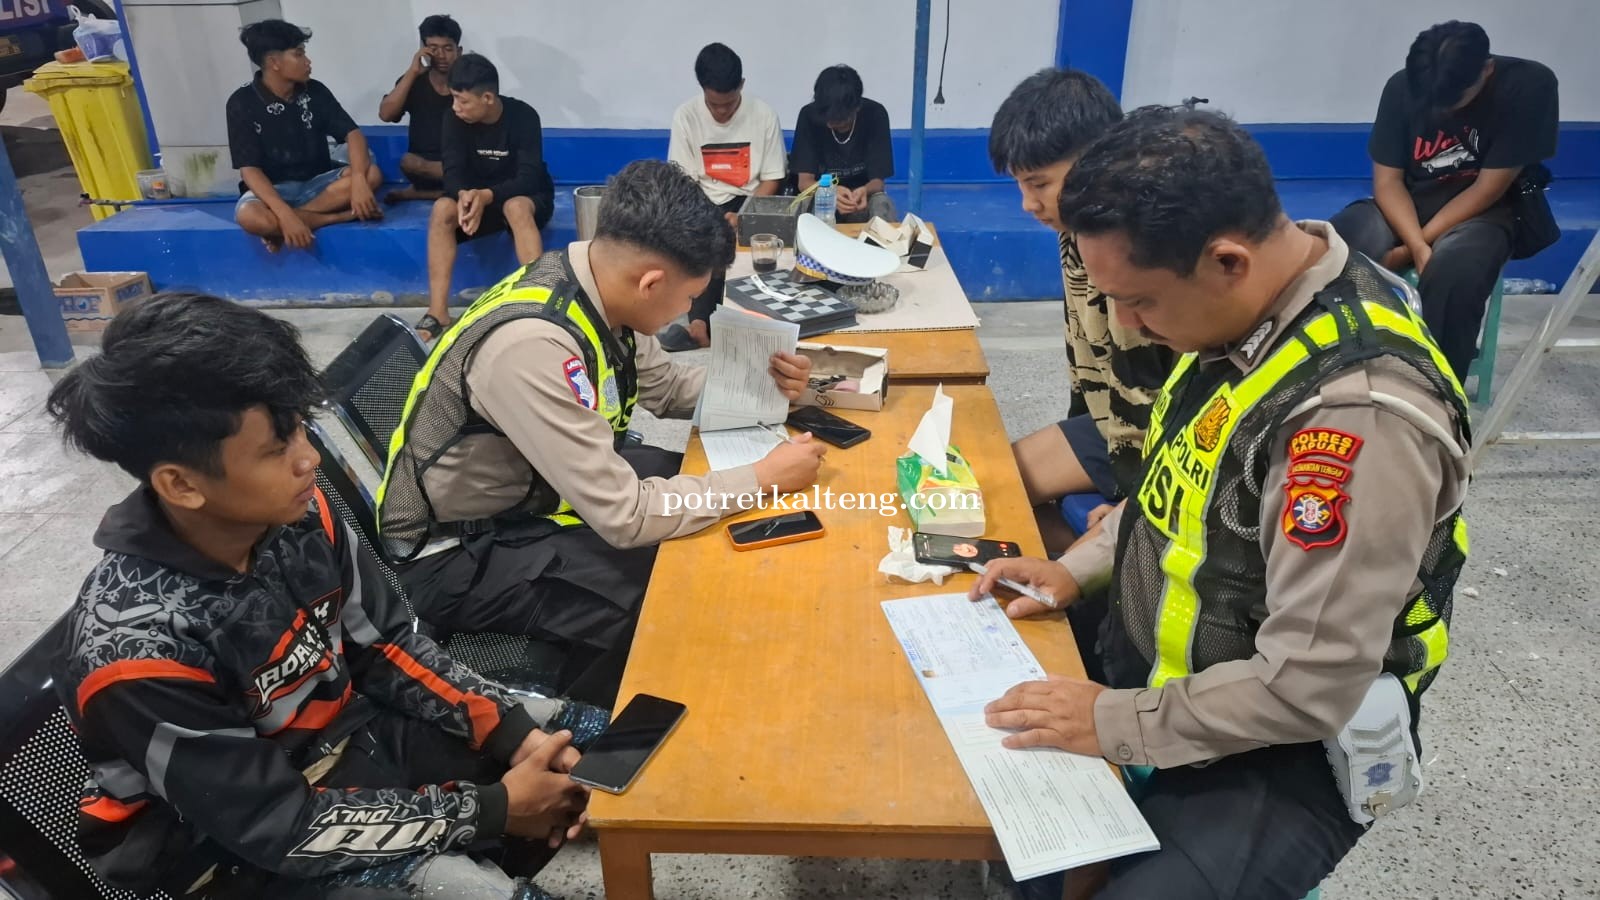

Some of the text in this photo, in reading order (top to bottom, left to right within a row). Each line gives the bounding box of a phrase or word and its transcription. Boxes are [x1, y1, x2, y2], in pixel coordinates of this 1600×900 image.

[1291, 431, 1353, 449] POLRES
[1294, 442, 1348, 455] KAPUAS
[1171, 433, 1210, 491] POLRI
